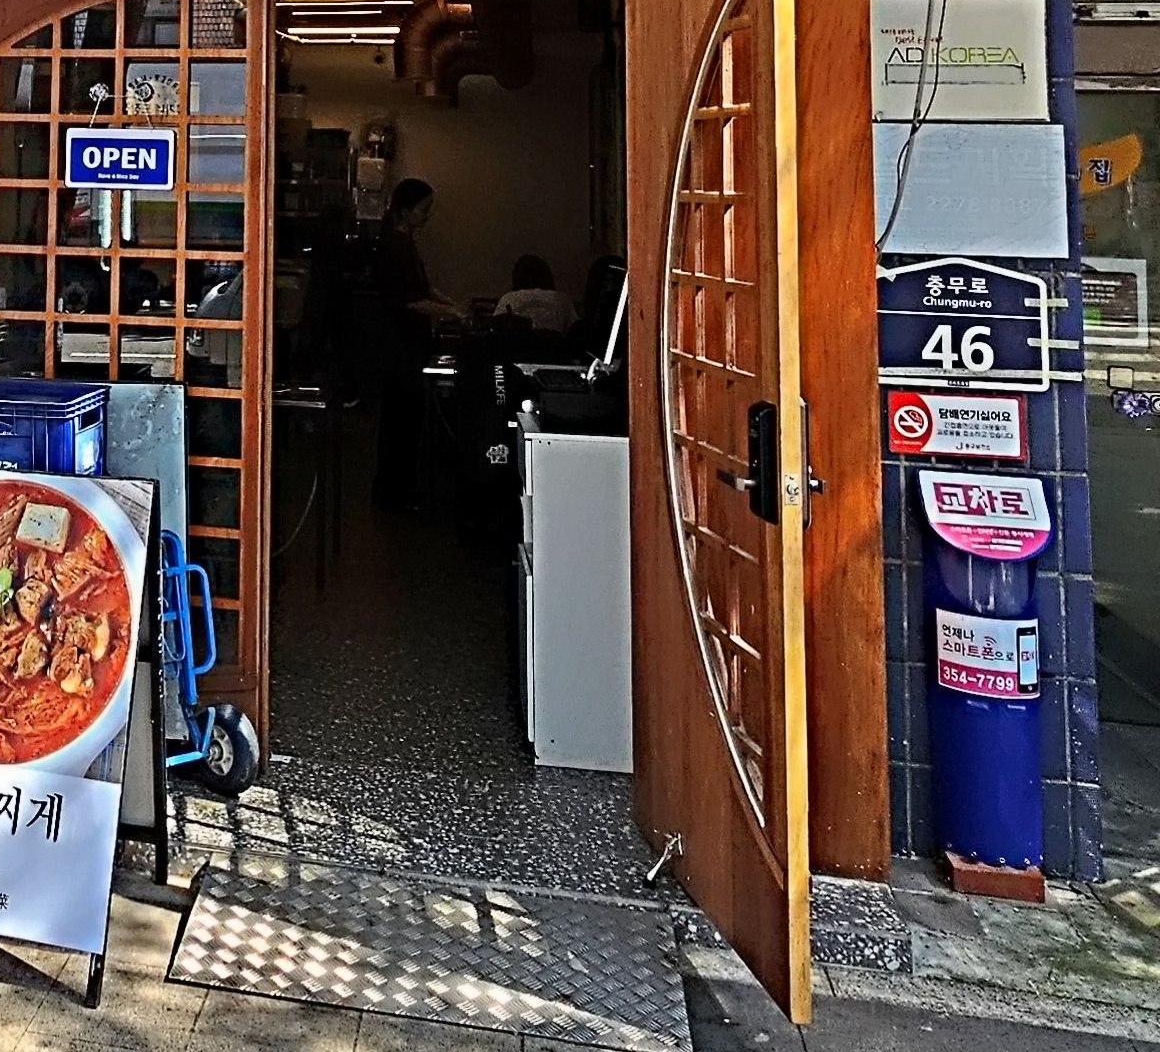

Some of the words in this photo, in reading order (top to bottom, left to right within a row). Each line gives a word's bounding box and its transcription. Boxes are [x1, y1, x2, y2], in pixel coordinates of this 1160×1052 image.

[887, 47, 924, 63] AD
[931, 47, 1020, 63] KOREA
[82, 146, 157, 170] OPEN
[924, 274, 989, 297] 충무로
[922, 295, 993, 310] Chungmu-ro
[920, 323, 995, 374] 46
[938, 408, 1012, 423] 담배연기싫어요
[940, 486, 1030, 516] 교차로
[942, 624, 975, 642] 언제나
[942, 639, 1014, 662] 스마트폰으로
[943, 666, 1015, 692] 354-7799
